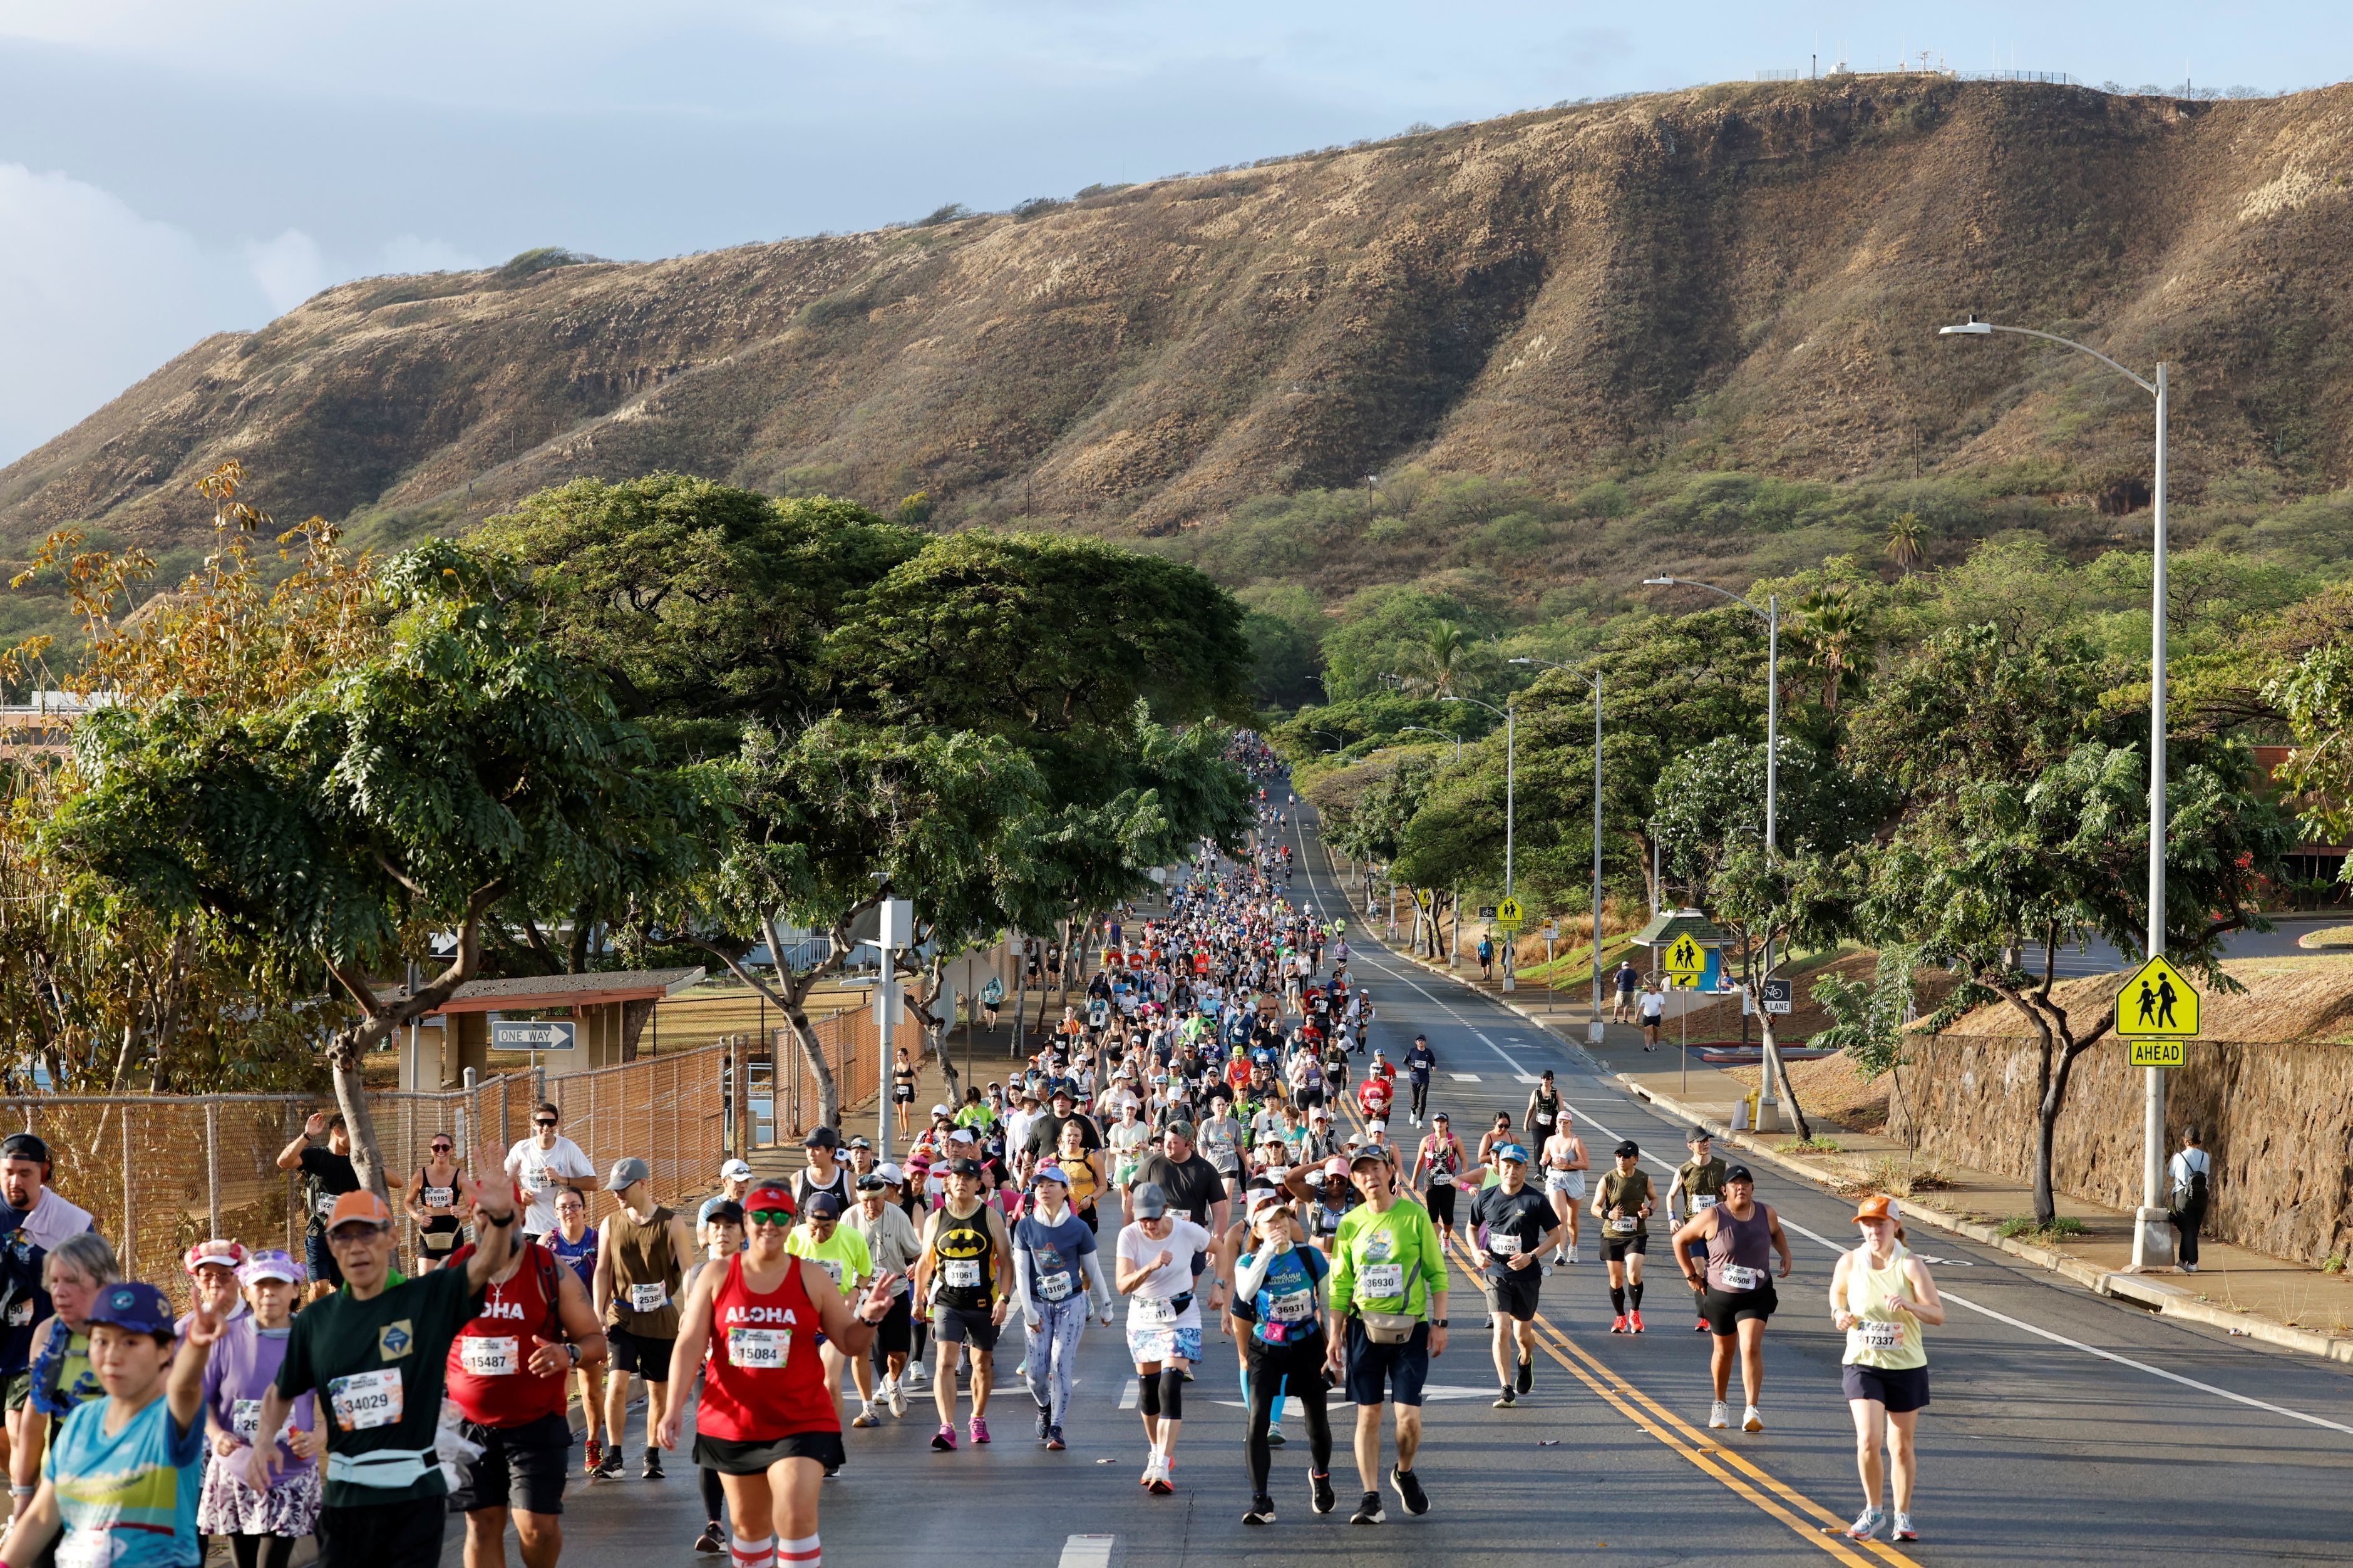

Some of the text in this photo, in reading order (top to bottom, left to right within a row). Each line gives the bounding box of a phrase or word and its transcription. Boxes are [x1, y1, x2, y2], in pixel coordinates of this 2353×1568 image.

[1751, 1002, 1789, 1011] BE LANE
[502, 1031, 550, 1041] ONE WAY
[2136, 1045, 2179, 1060] AHEAD
[1268, 1277, 1302, 1286] MARATHON
[1367, 1278, 1394, 1288] 36930
[1729, 1275, 1750, 1284] 26508
[1044, 1283, 1066, 1294] 13105
[639, 1293, 662, 1304] 25385
[1277, 1304, 1305, 1314] 36931
[724, 1306, 797, 1325] ALOHA
[1865, 1336, 1895, 1345] 17337
[739, 1348, 777, 1360] 15084
[471, 1356, 507, 1368] 15487
[346, 1393, 388, 1413] 34029
